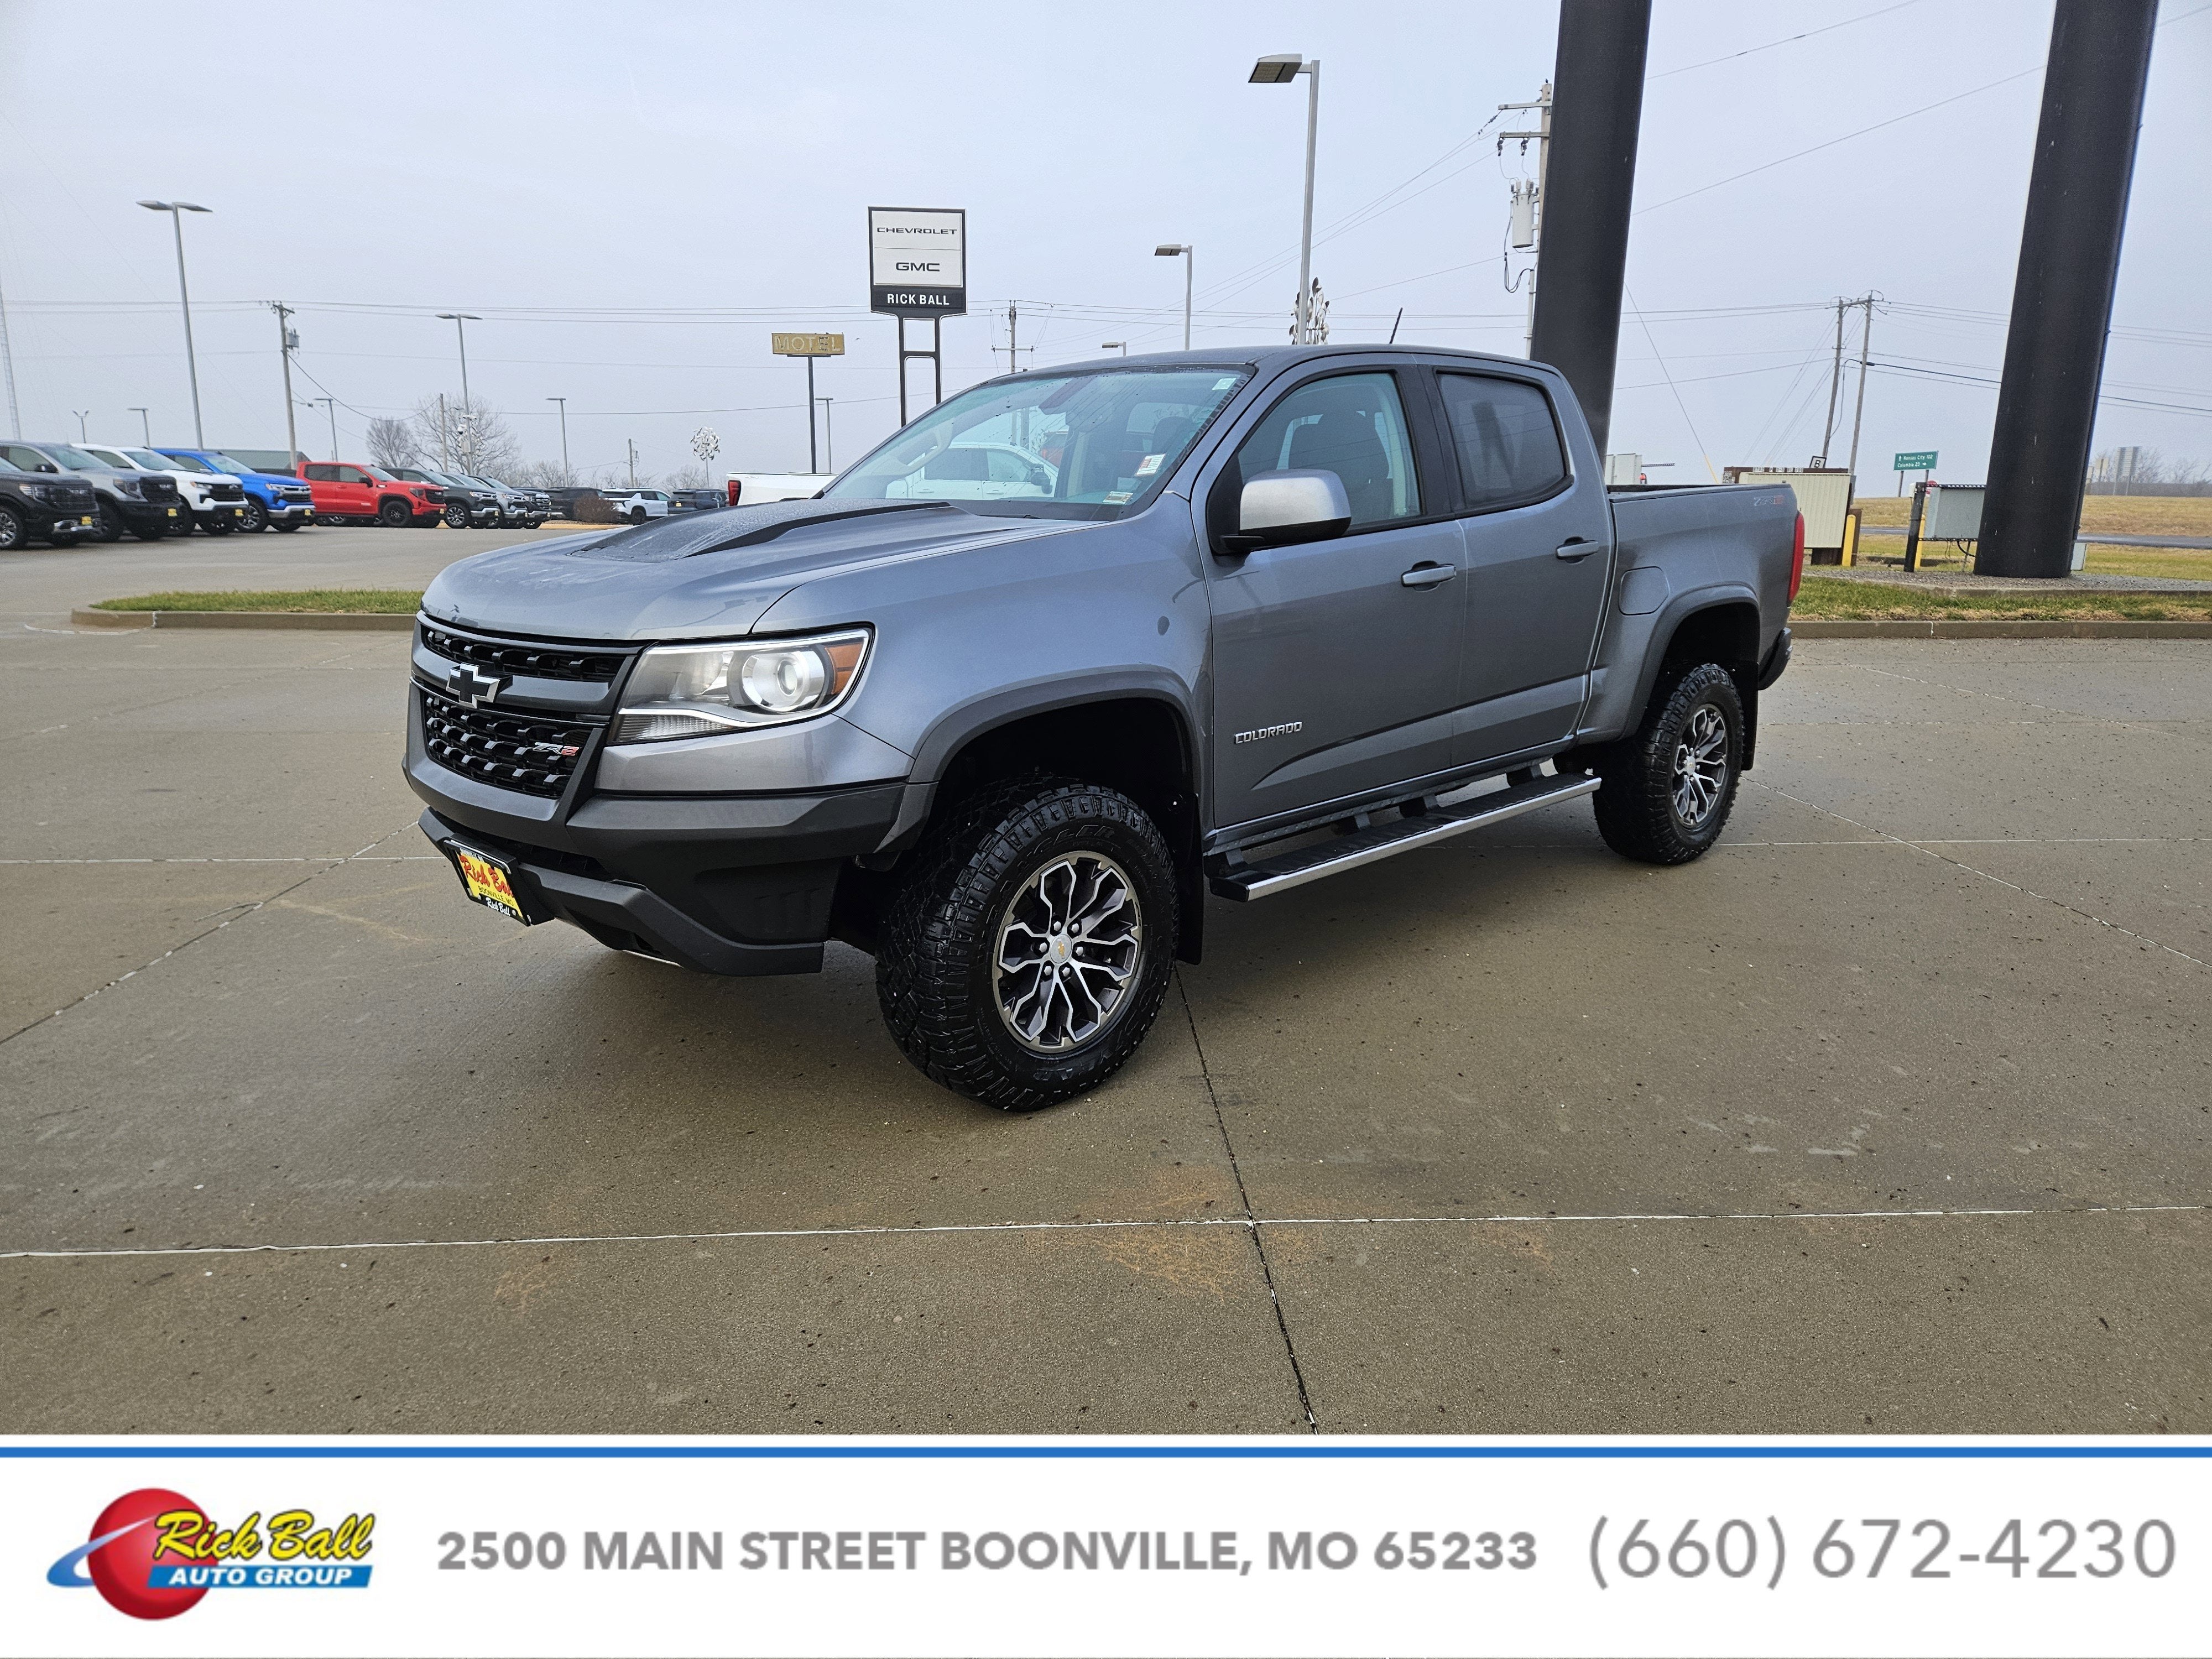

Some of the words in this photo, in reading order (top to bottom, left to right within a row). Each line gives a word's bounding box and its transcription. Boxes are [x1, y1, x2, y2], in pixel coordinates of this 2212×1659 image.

[895, 262, 940, 272] GMC
[886, 294, 917, 305] RICK
[920, 294, 950, 306] BALL
[774, 335, 841, 352] MOTEL
[1235, 721, 1302, 744] COLORADO
[533, 742, 580, 757] ZR2
[459, 855, 490, 888] Rick
[486, 897, 499, 911] Rick
[498, 902, 511, 916] Ball
